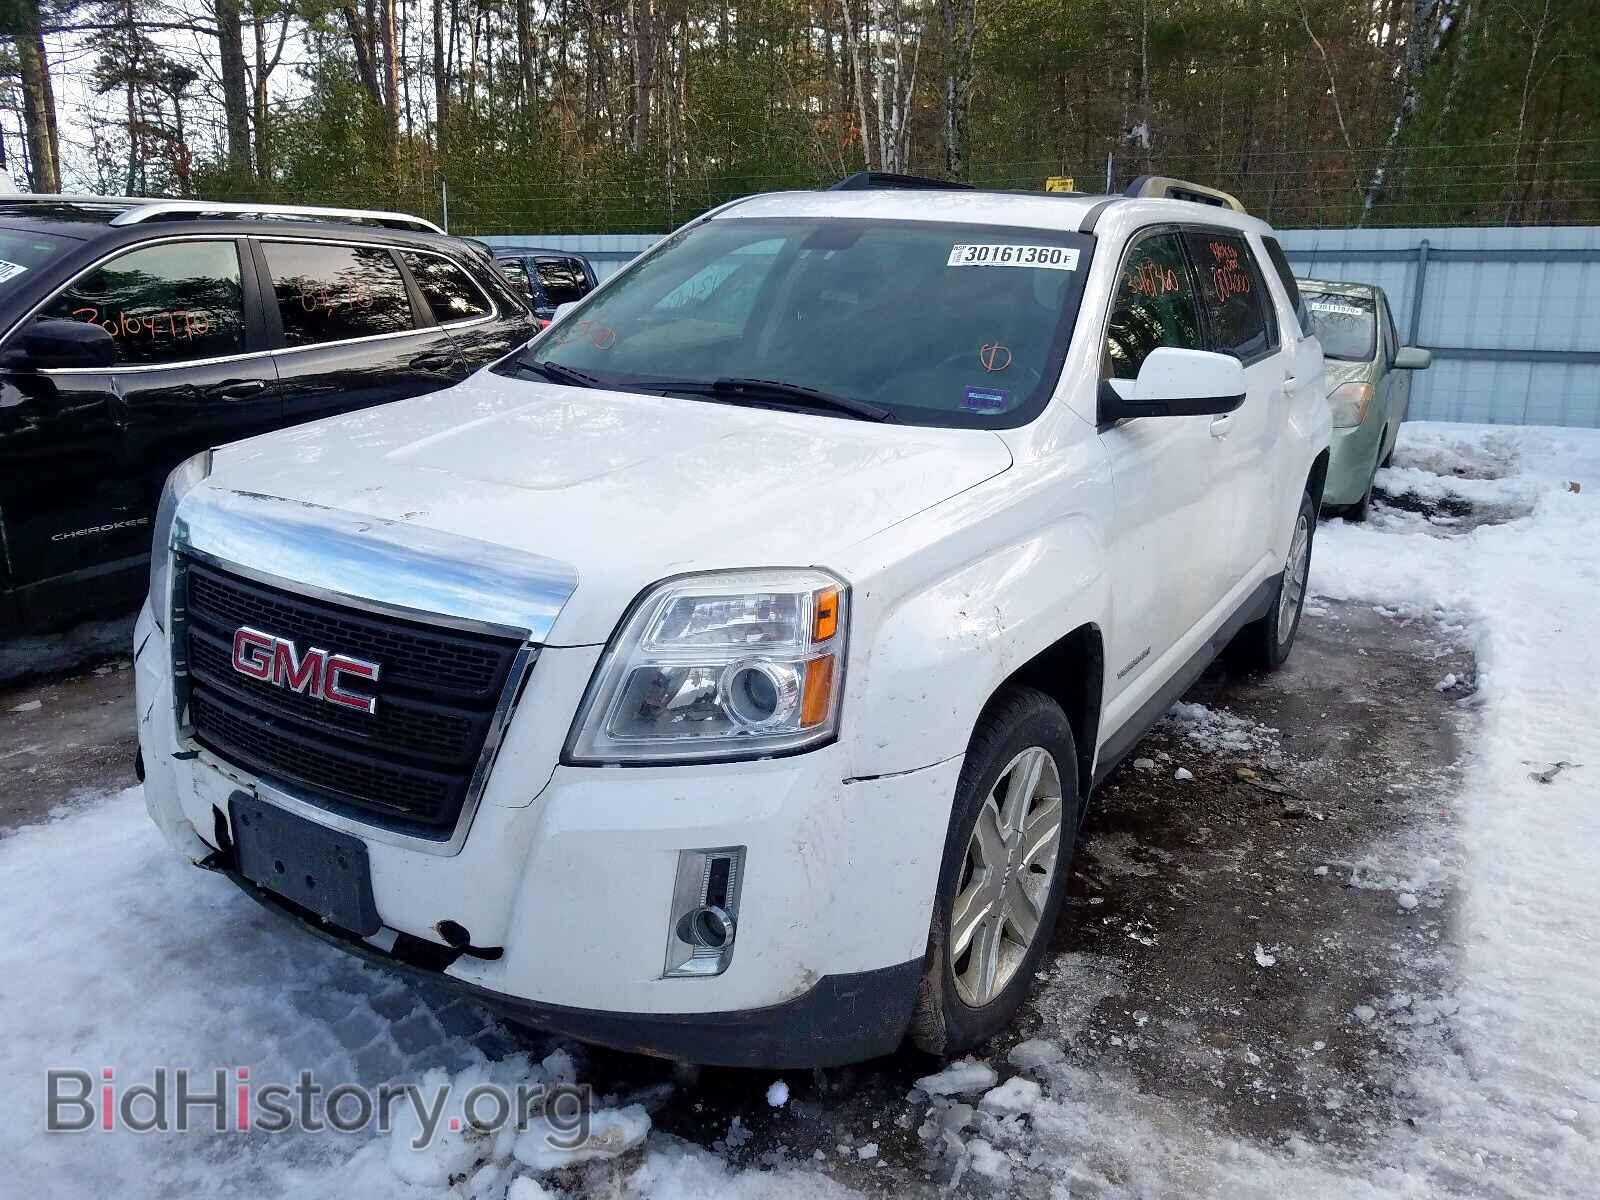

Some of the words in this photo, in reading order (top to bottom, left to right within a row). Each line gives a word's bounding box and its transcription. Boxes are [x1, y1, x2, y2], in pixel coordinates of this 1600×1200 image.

[965, 246, 1062, 265] 30161360
[1064, 255, 1071, 263] F
[51, 517, 150, 541] CHEROKEE
[232, 626, 382, 715] GMC
